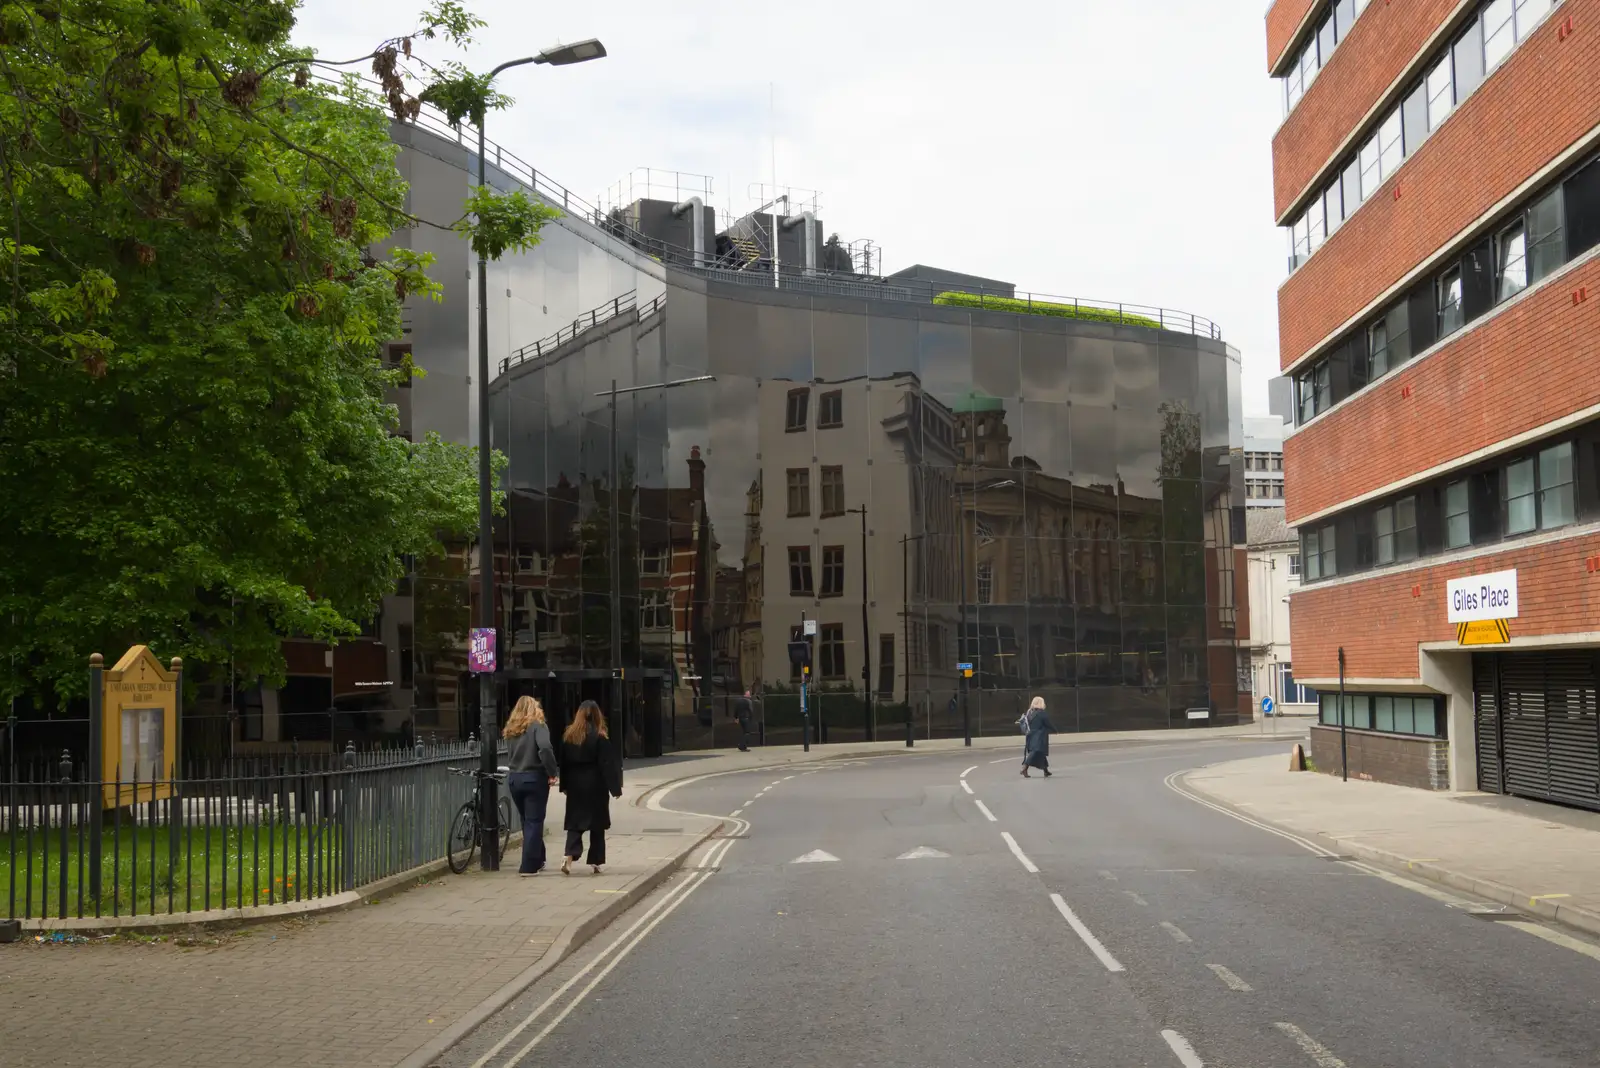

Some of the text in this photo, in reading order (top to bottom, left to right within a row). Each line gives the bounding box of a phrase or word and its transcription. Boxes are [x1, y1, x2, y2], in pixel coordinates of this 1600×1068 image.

[1453, 585, 1509, 611] Giles Place
[477, 652, 493, 664] GUM
